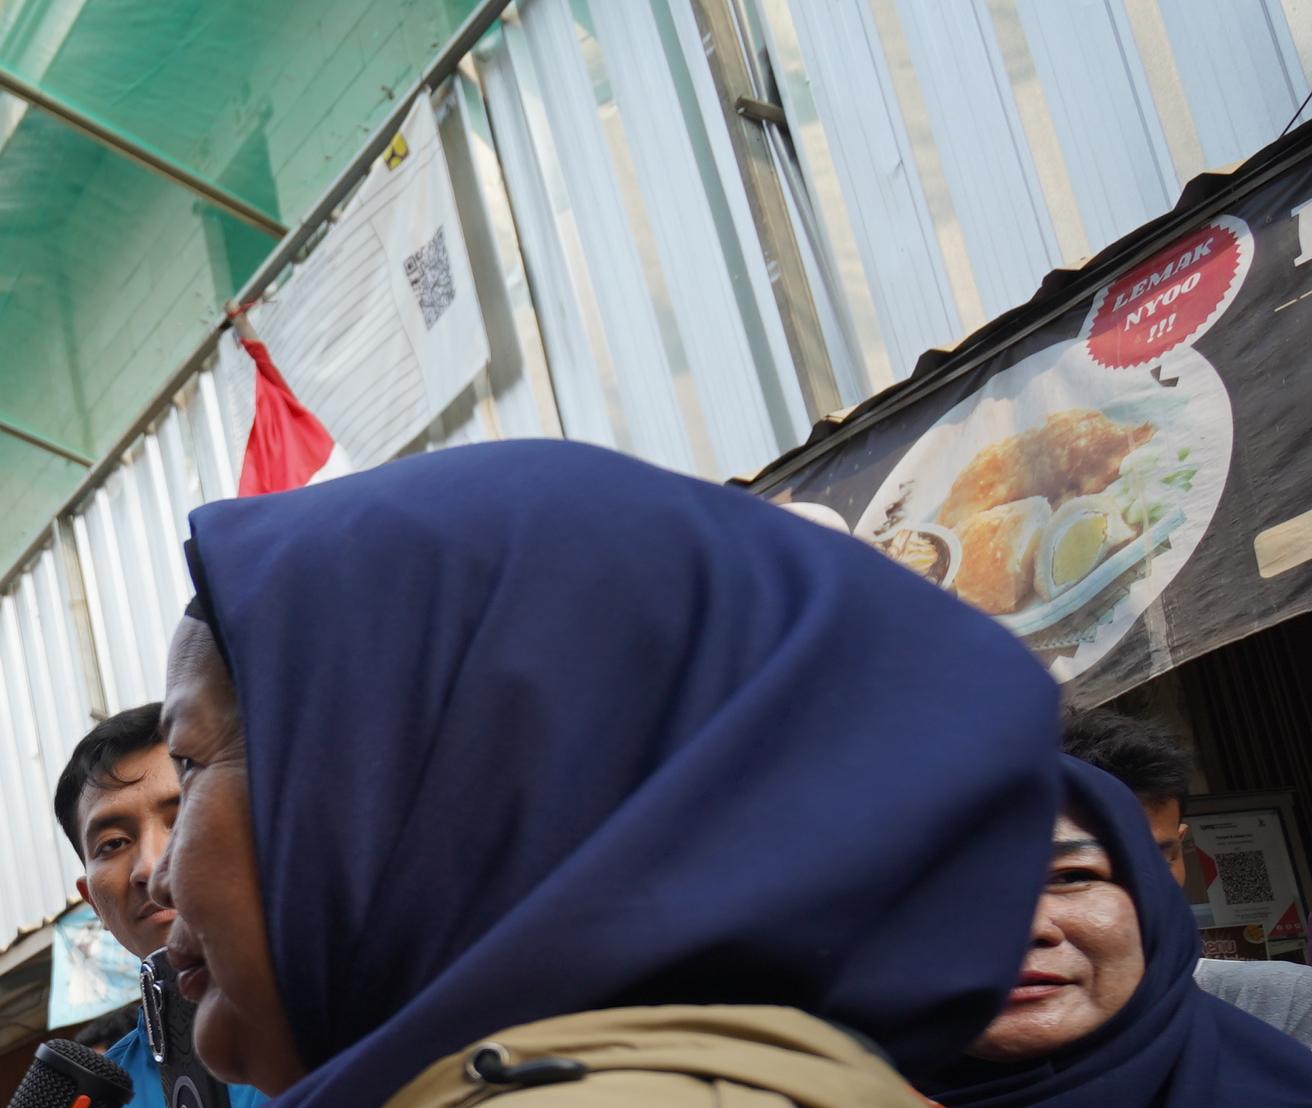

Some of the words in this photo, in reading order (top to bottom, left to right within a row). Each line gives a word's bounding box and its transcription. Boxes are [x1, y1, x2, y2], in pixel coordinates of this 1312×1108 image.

[1112, 236, 1215, 313] LEMAK
[1124, 272, 1201, 332] NYOO
[1146, 312, 1177, 344] !!!
[1202, 938, 1237, 956] enu
